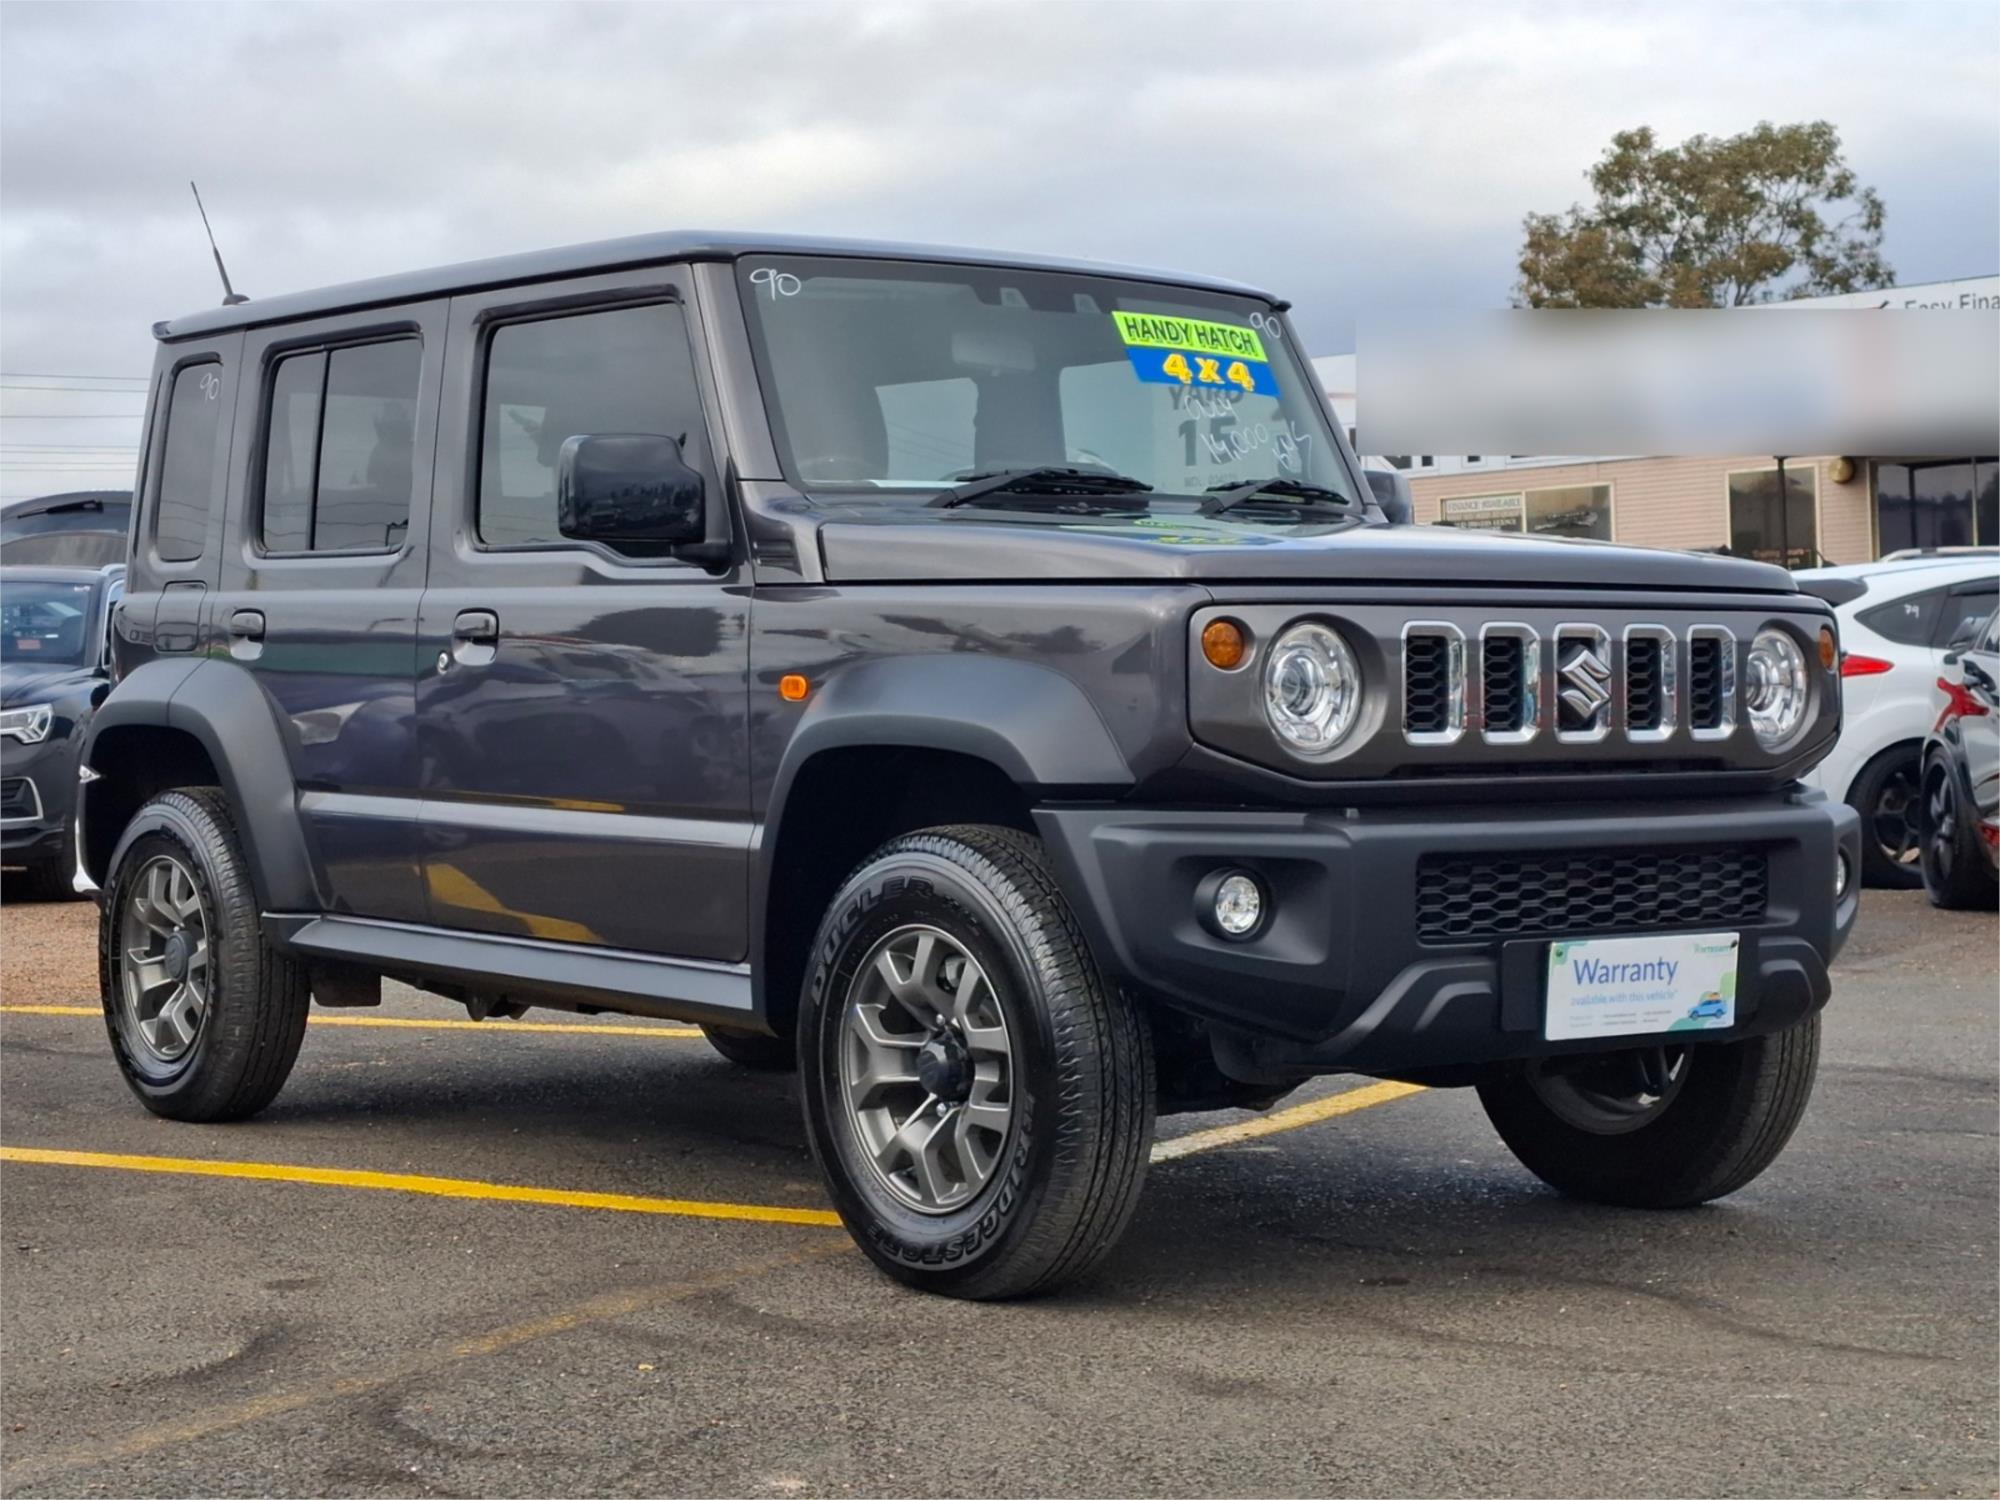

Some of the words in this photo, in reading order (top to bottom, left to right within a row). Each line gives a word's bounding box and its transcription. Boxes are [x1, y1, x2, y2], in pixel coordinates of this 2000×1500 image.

[749, 267, 802, 302] 90
[1123, 316, 1190, 343] HANDY
[1194, 324, 1257, 354] HATCH
[1250, 312, 1282, 339] 90
[199, 372, 220, 404] 90
[1178, 415, 1237, 467] 15
[1572, 957, 1679, 986] Warranty
